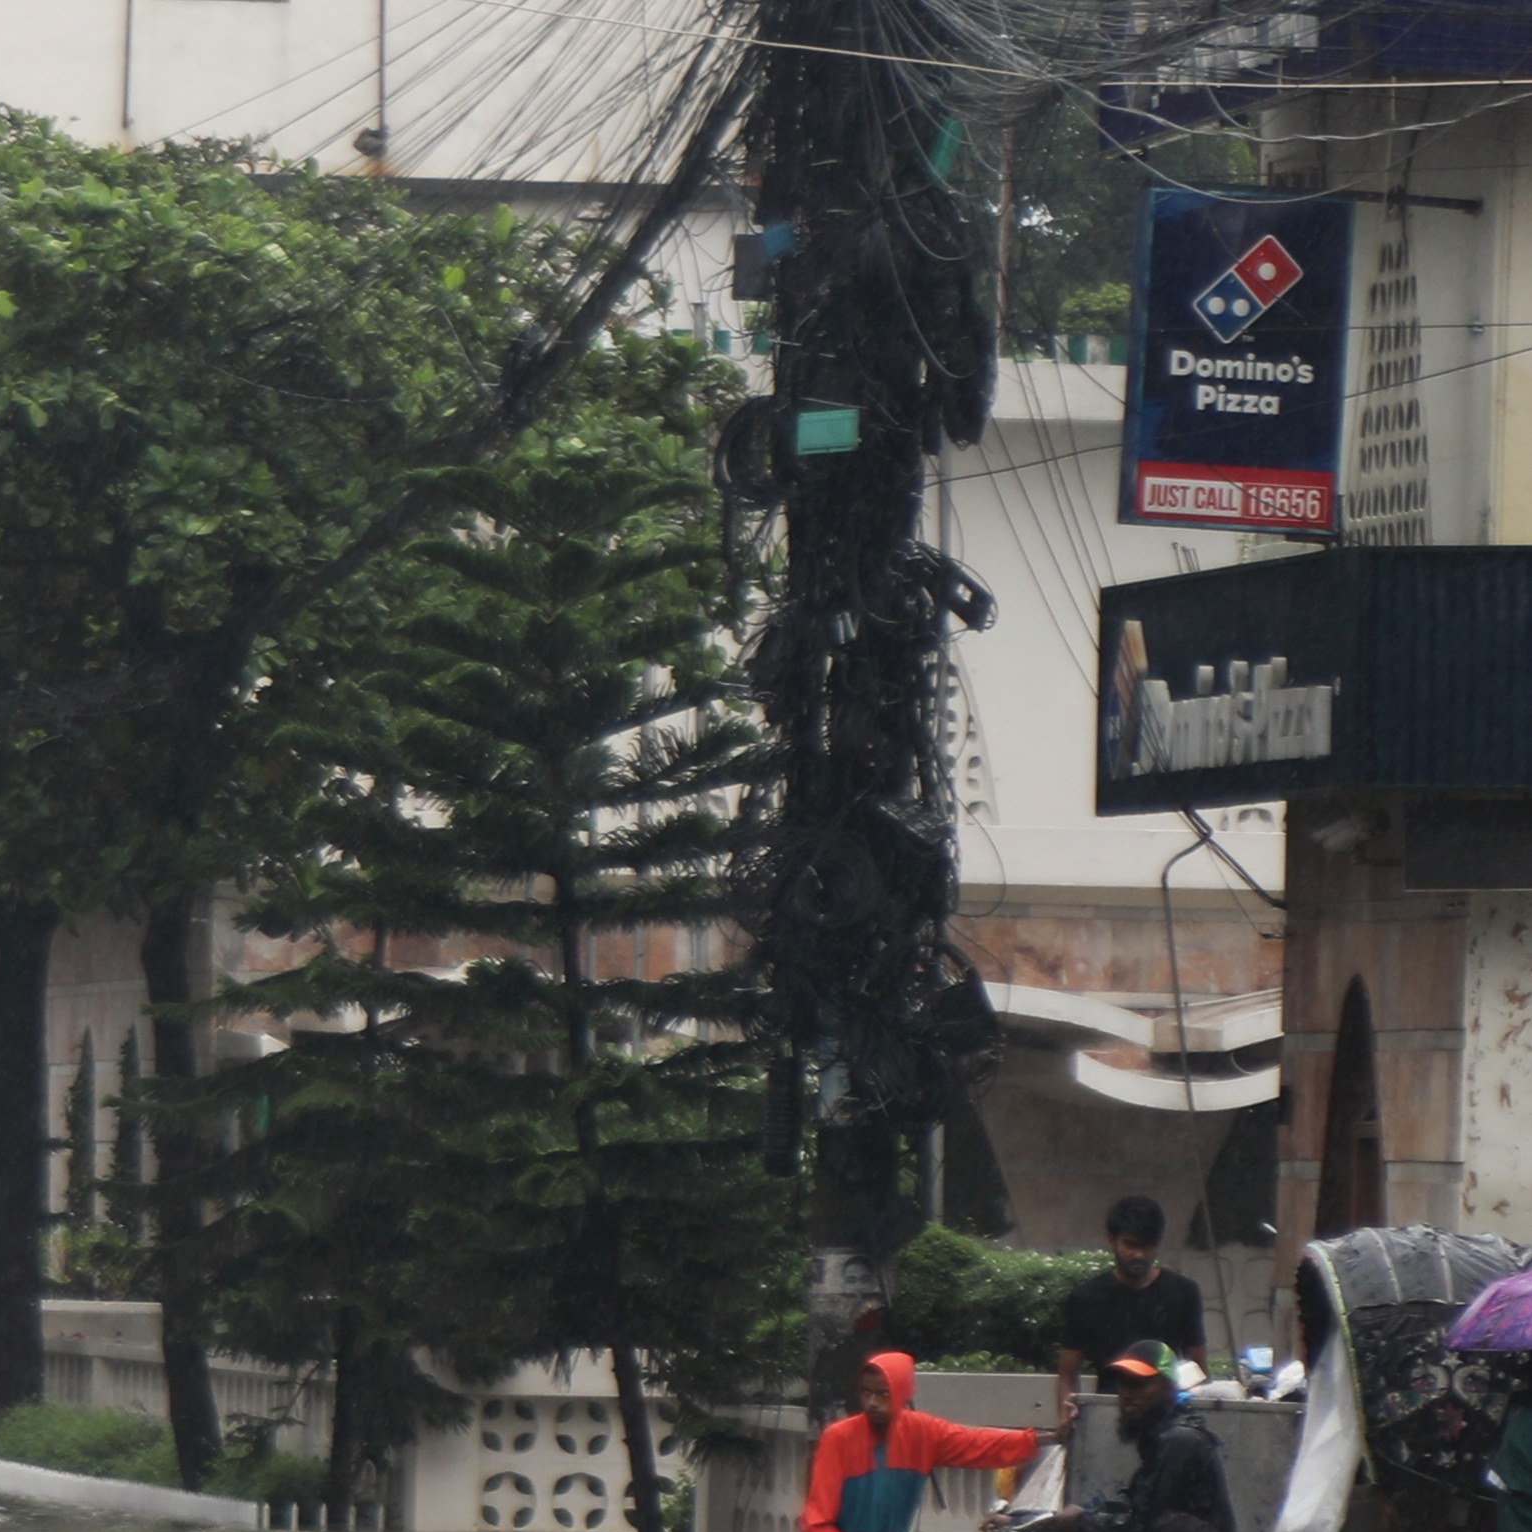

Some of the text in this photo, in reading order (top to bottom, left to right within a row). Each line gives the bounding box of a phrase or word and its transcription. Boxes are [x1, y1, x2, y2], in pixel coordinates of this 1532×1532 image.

[1170, 349, 1315, 384] Domino's
[1196, 385, 1280, 415] Pizza
[1147, 484, 1322, 520] JUST CALL 16656
